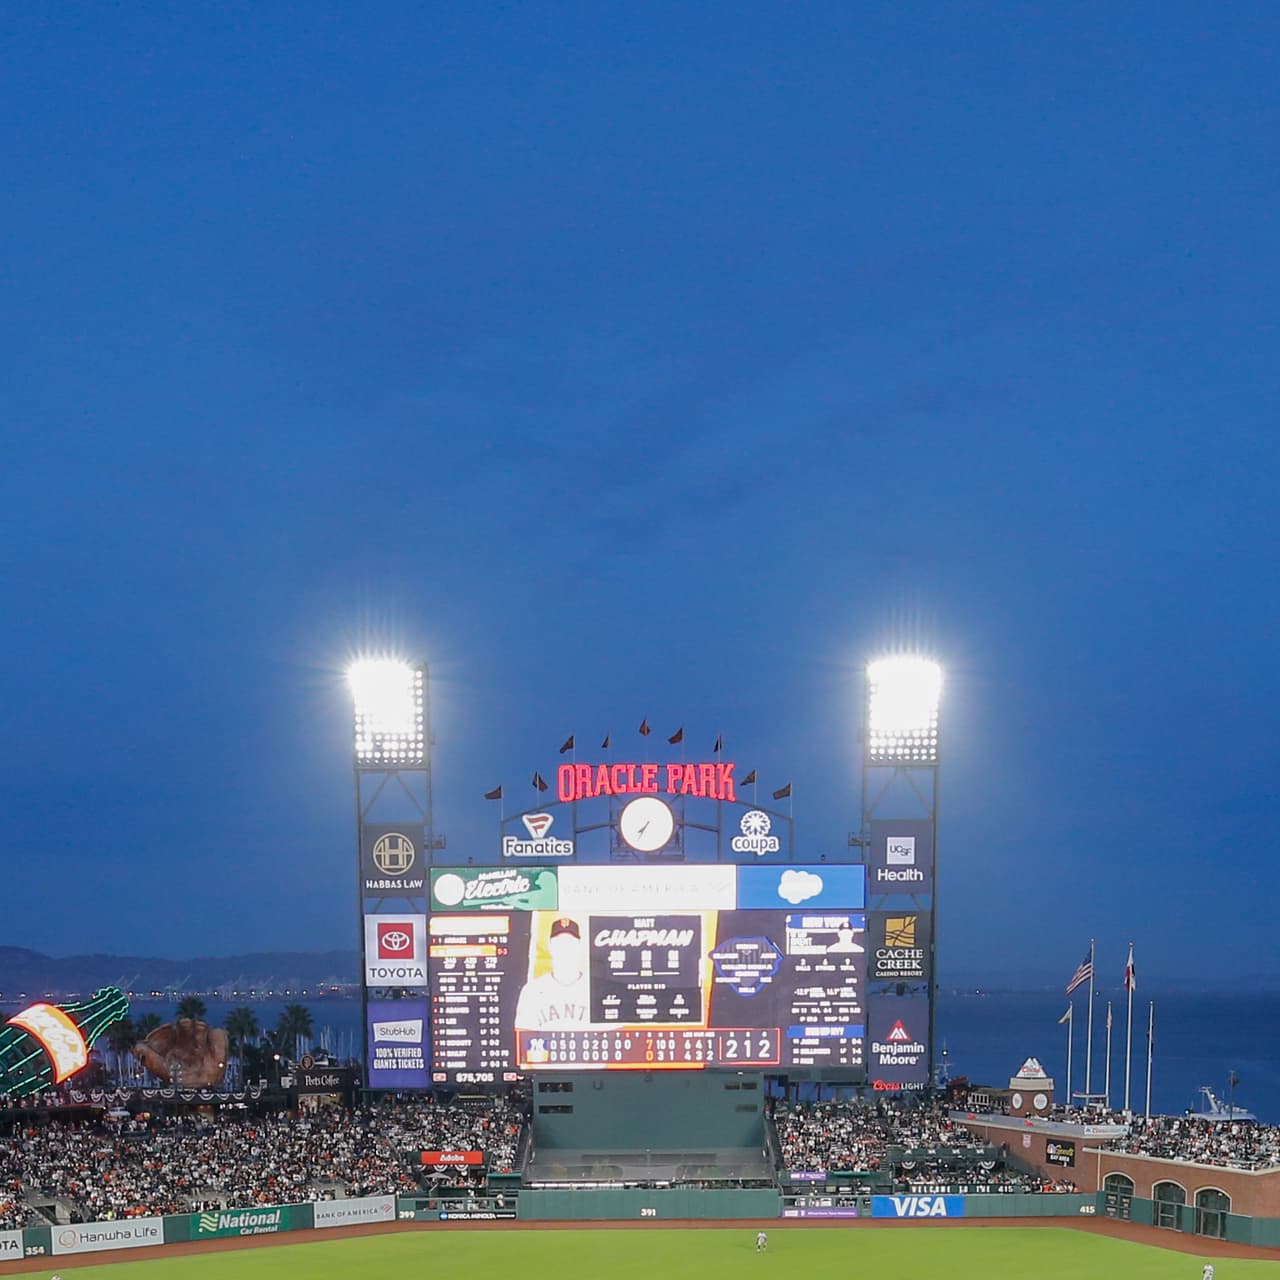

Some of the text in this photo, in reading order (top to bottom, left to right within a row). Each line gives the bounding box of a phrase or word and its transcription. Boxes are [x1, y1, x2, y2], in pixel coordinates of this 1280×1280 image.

[557, 762, 737, 803] ORACLE PARK
[505, 838, 572, 854] Fanatics
[734, 838, 777, 854] coupa
[877, 868, 923, 881] Health
[366, 879, 423, 889] HABBAS LAW
[593, 930, 694, 948] CHAPMAN
[875, 948, 924, 959] CACHE
[877, 960, 922, 970] CREEK
[369, 967, 424, 978] TOYOTA
[379, 1027, 416, 1036] StubHub
[656, 1039, 666, 1050] 10
[668, 1039, 675, 1050] 0
[726, 1040, 770, 1058] 2 1 2
[872, 1042, 925, 1055] Benjamin
[375, 1047, 422, 1058] 100% VERIFIED
[374, 1058, 424, 1069] GIANTS TICKETS
[879, 1055, 917, 1065] Moore
[901, 1082, 924, 1090] LIGHT
[440, 1154, 466, 1162] Adobe
[998, 1185, 1014, 1193] 415
[347, 1208, 378, 1216] AMERICA
[888, 1197, 948, 1216] VISA
[1079, 1205, 1096, 1214] 415
[399, 1211, 415, 1219] 399
[640, 1208, 657, 1217] 391
[219, 1209, 281, 1229] National
[80, 1226, 158, 1244] Hanwha Life
[240, 1225, 278, 1236] Car Rental
[25, 1246, 45, 1256] 354
